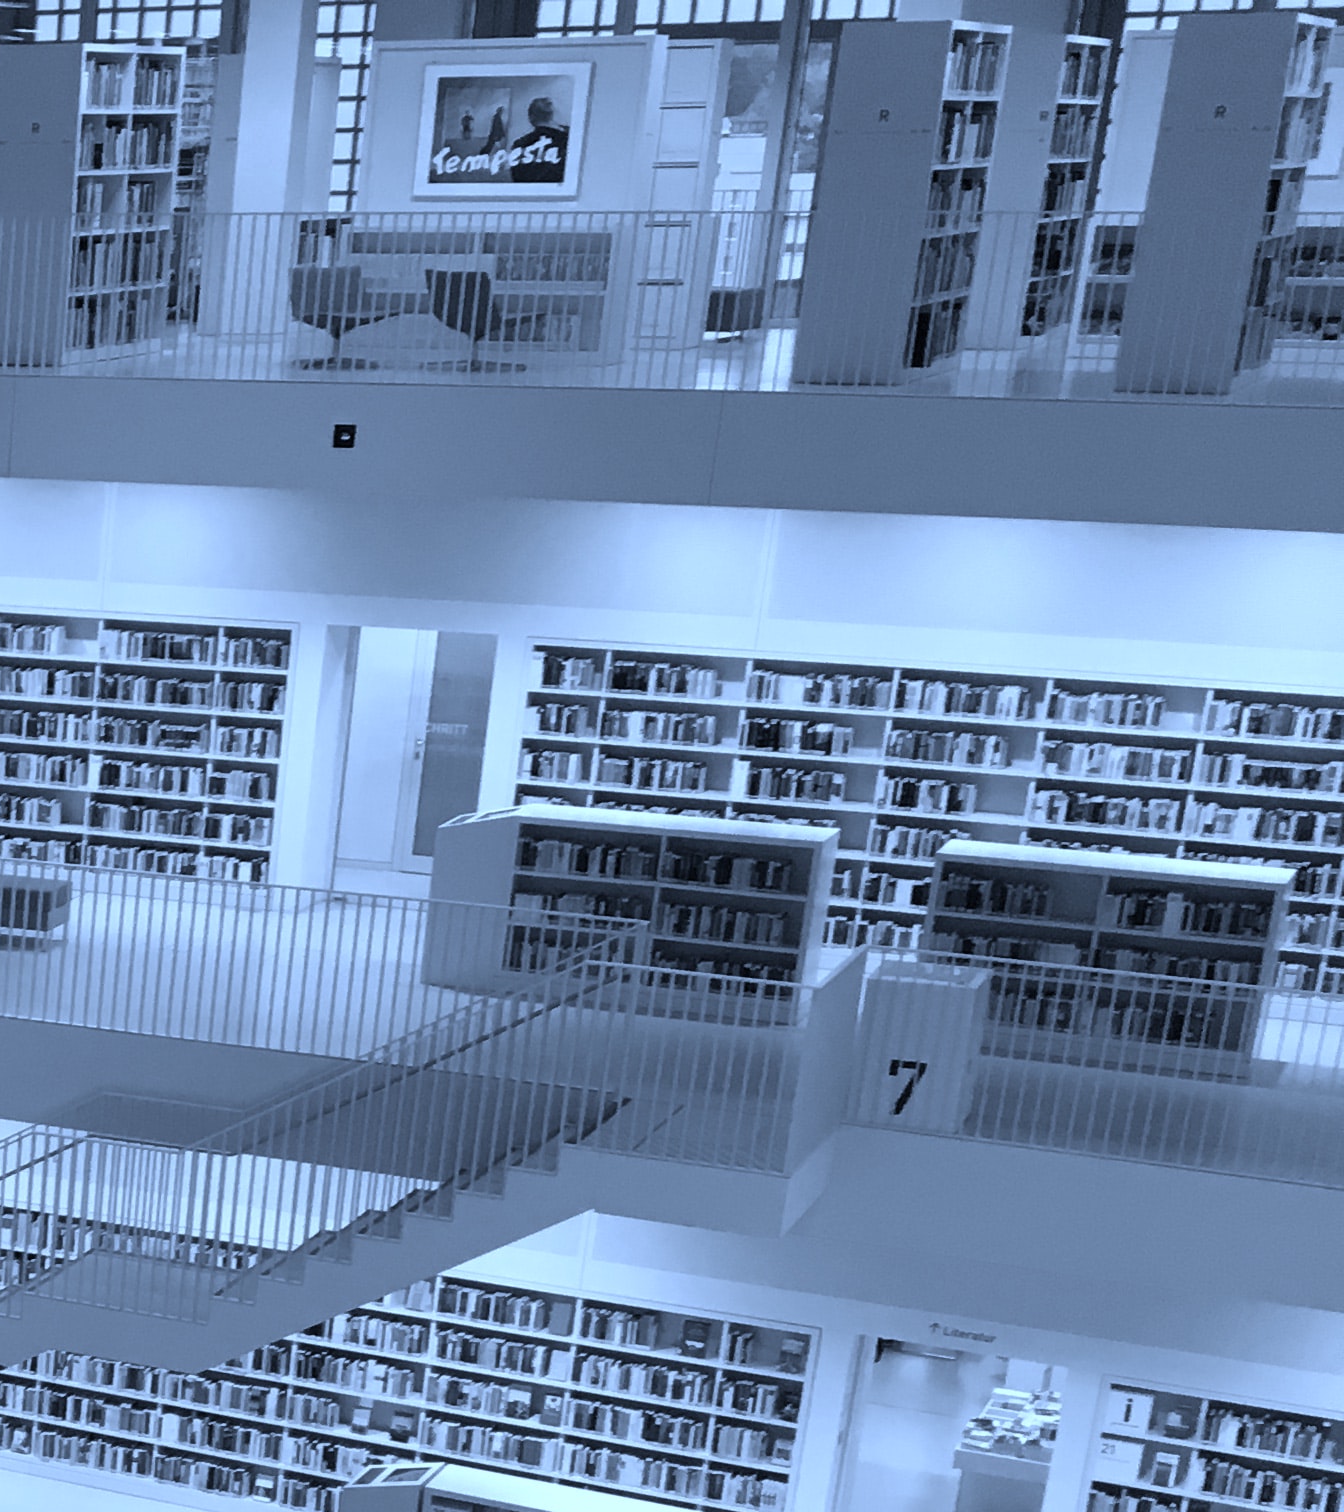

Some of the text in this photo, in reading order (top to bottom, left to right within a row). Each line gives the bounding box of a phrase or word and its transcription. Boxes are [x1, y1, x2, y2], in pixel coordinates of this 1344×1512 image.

[879, 109, 891, 123] R
[1214, 105, 1227, 119] R
[432, 136, 561, 175] Tempesta
[888, 1059, 928, 1116] 7
